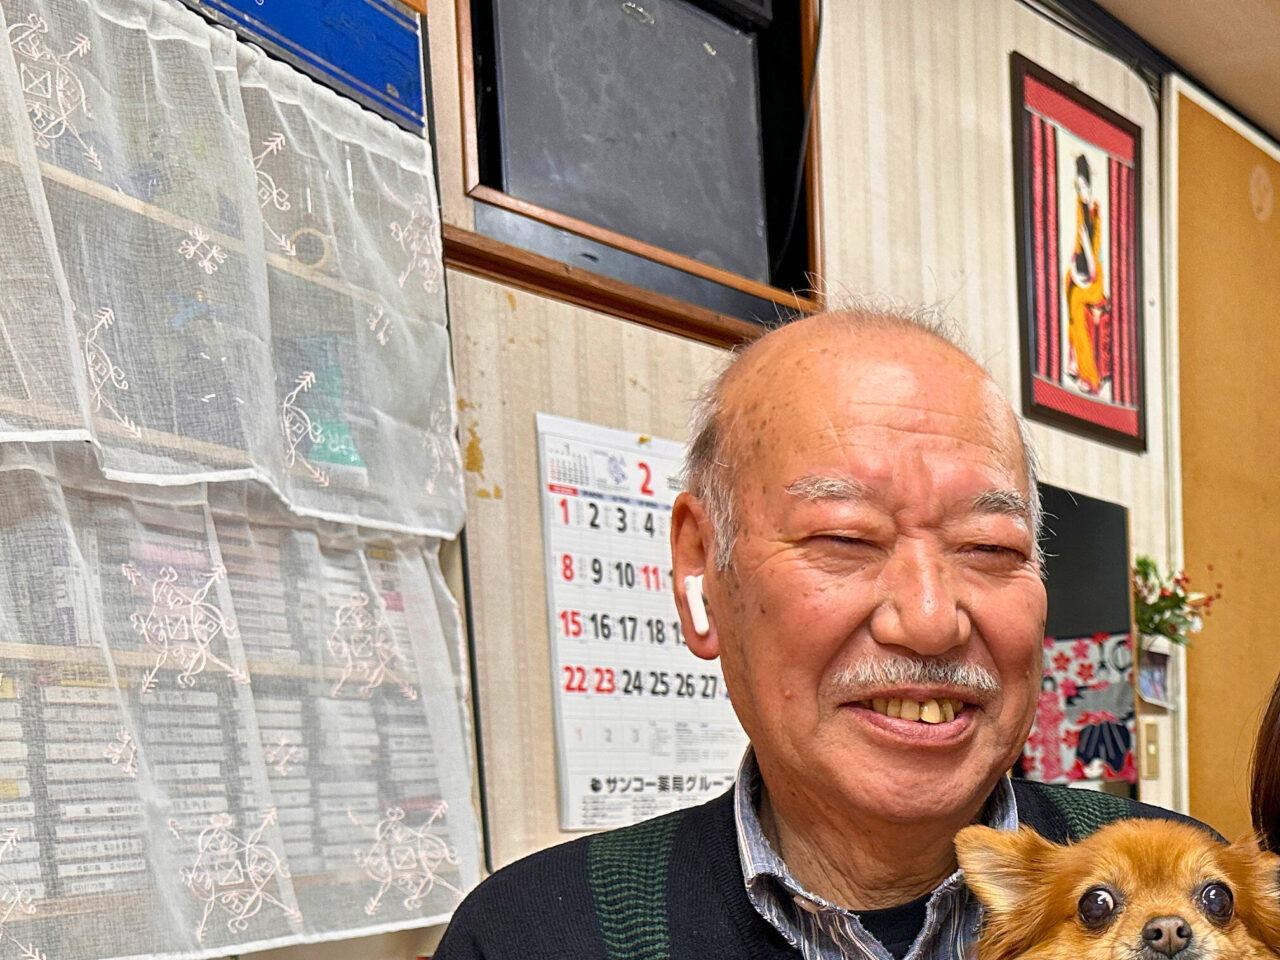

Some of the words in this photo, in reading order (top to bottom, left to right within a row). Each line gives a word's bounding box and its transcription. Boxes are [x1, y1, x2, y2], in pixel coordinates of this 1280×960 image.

[637, 461, 655, 496] 2
[560, 498, 570, 525] 1
[588, 502, 600, 530] 2
[616, 507, 627, 533] 3
[644, 512, 655, 537] 4
[561, 553, 575, 582] 8
[591, 558, 603, 584] 9
[615, 561, 635, 589] 10
[641, 565, 661, 591] 11
[559, 610, 582, 637] 15
[590, 613, 611, 640] 16
[618, 616, 638, 642] 17
[646, 619, 666, 645] 18
[672, 621, 687, 645] 1
[563, 665, 587, 693] 22
[593, 667, 616, 694] 23
[621, 669, 644, 696] 24
[650, 671, 670, 697] 25
[675, 673, 696, 698] 26
[700, 675, 718, 699] 27
[604, 727, 613, 743] 2
[631, 727, 640, 743] 3
